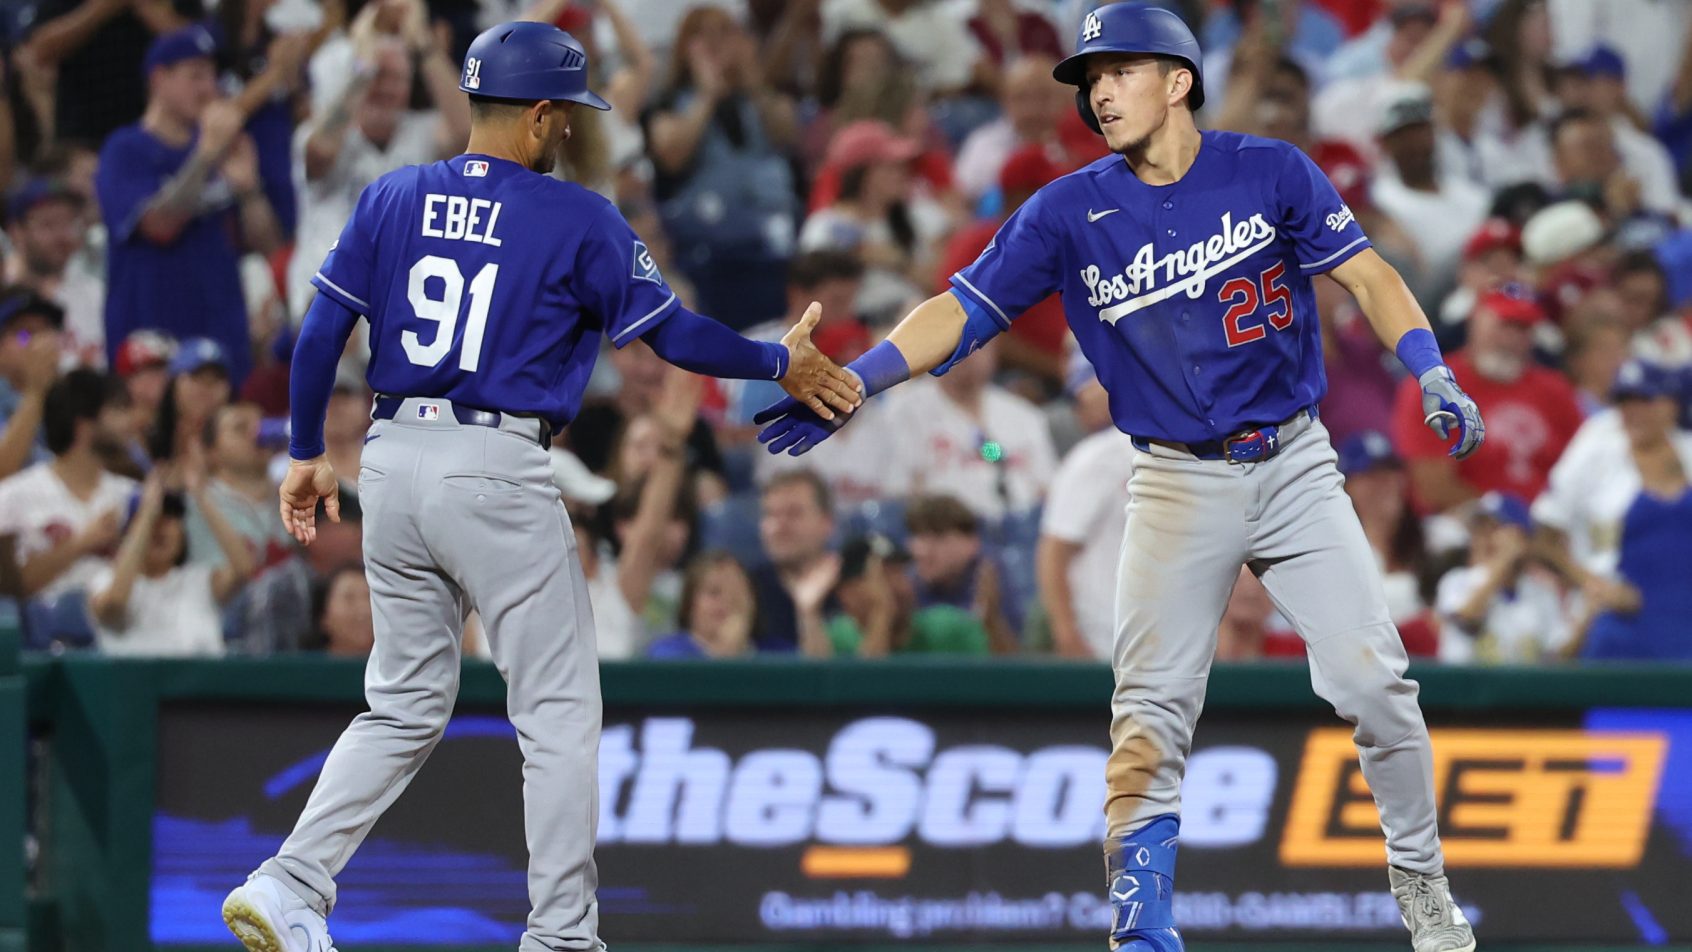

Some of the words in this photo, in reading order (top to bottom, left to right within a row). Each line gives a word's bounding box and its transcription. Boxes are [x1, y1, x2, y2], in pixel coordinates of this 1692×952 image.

[467, 57, 481, 77] 91
[422, 193, 502, 247] EBEL
[401, 255, 499, 372] 91
[1218, 259, 1294, 348] 25
[595, 716, 1280, 847] theScoe
